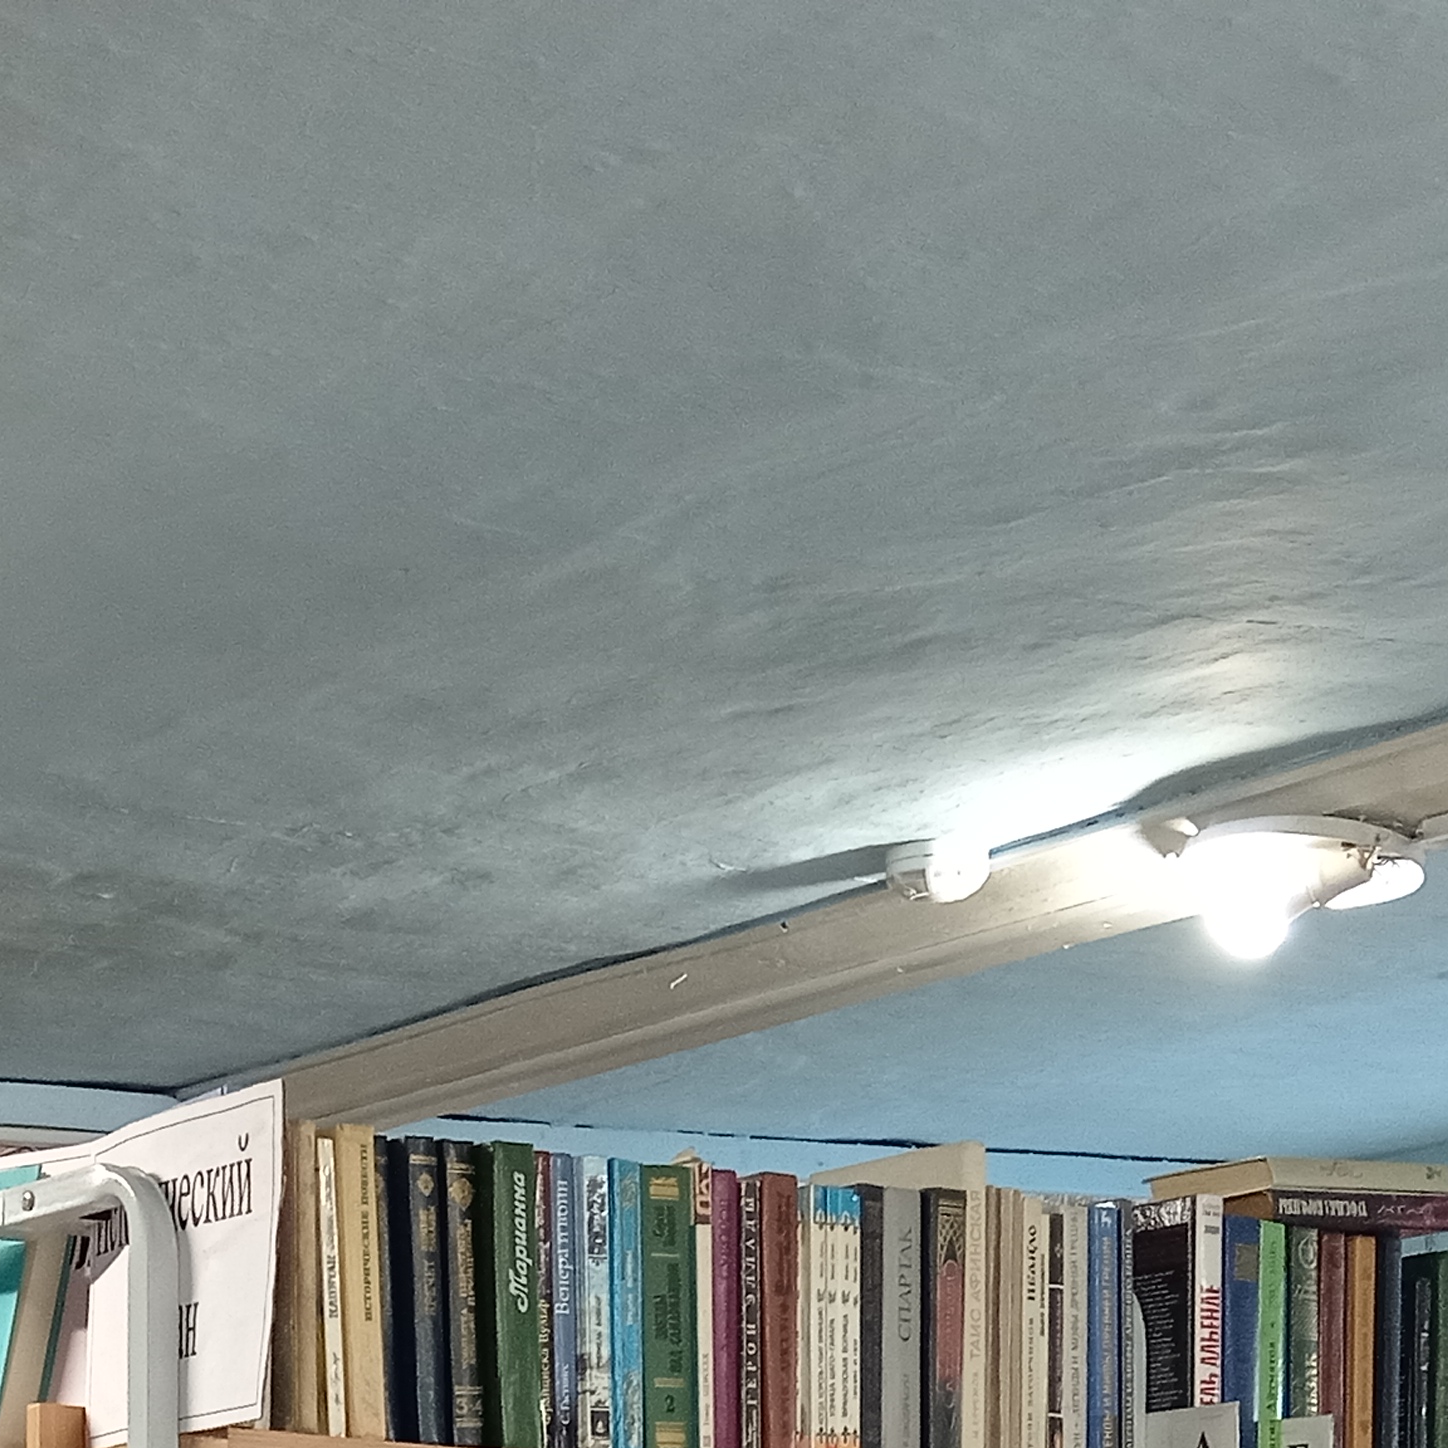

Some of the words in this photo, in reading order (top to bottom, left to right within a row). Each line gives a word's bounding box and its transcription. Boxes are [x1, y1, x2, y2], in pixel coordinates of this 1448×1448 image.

[360, 1143, 369, 1206] ПОВЕСТИ
[361, 1210, 372, 1321] ИСТОРИЧЕСКИЕ
[509, 1170, 533, 1313] Марианна
[743, 1197, 756, 1304] ЭЛЛАДЫ
[897, 1227, 912, 1342] СПАРТАК
[969, 1190, 982, 1302] АФИНСКАЯ
[744, 1323, 758, 1406] ГЕРОИ
[970, 1309, 982, 1360] ТАИС
[1199, 1284, 1220, 1366] АЛЬЕНДЕ
